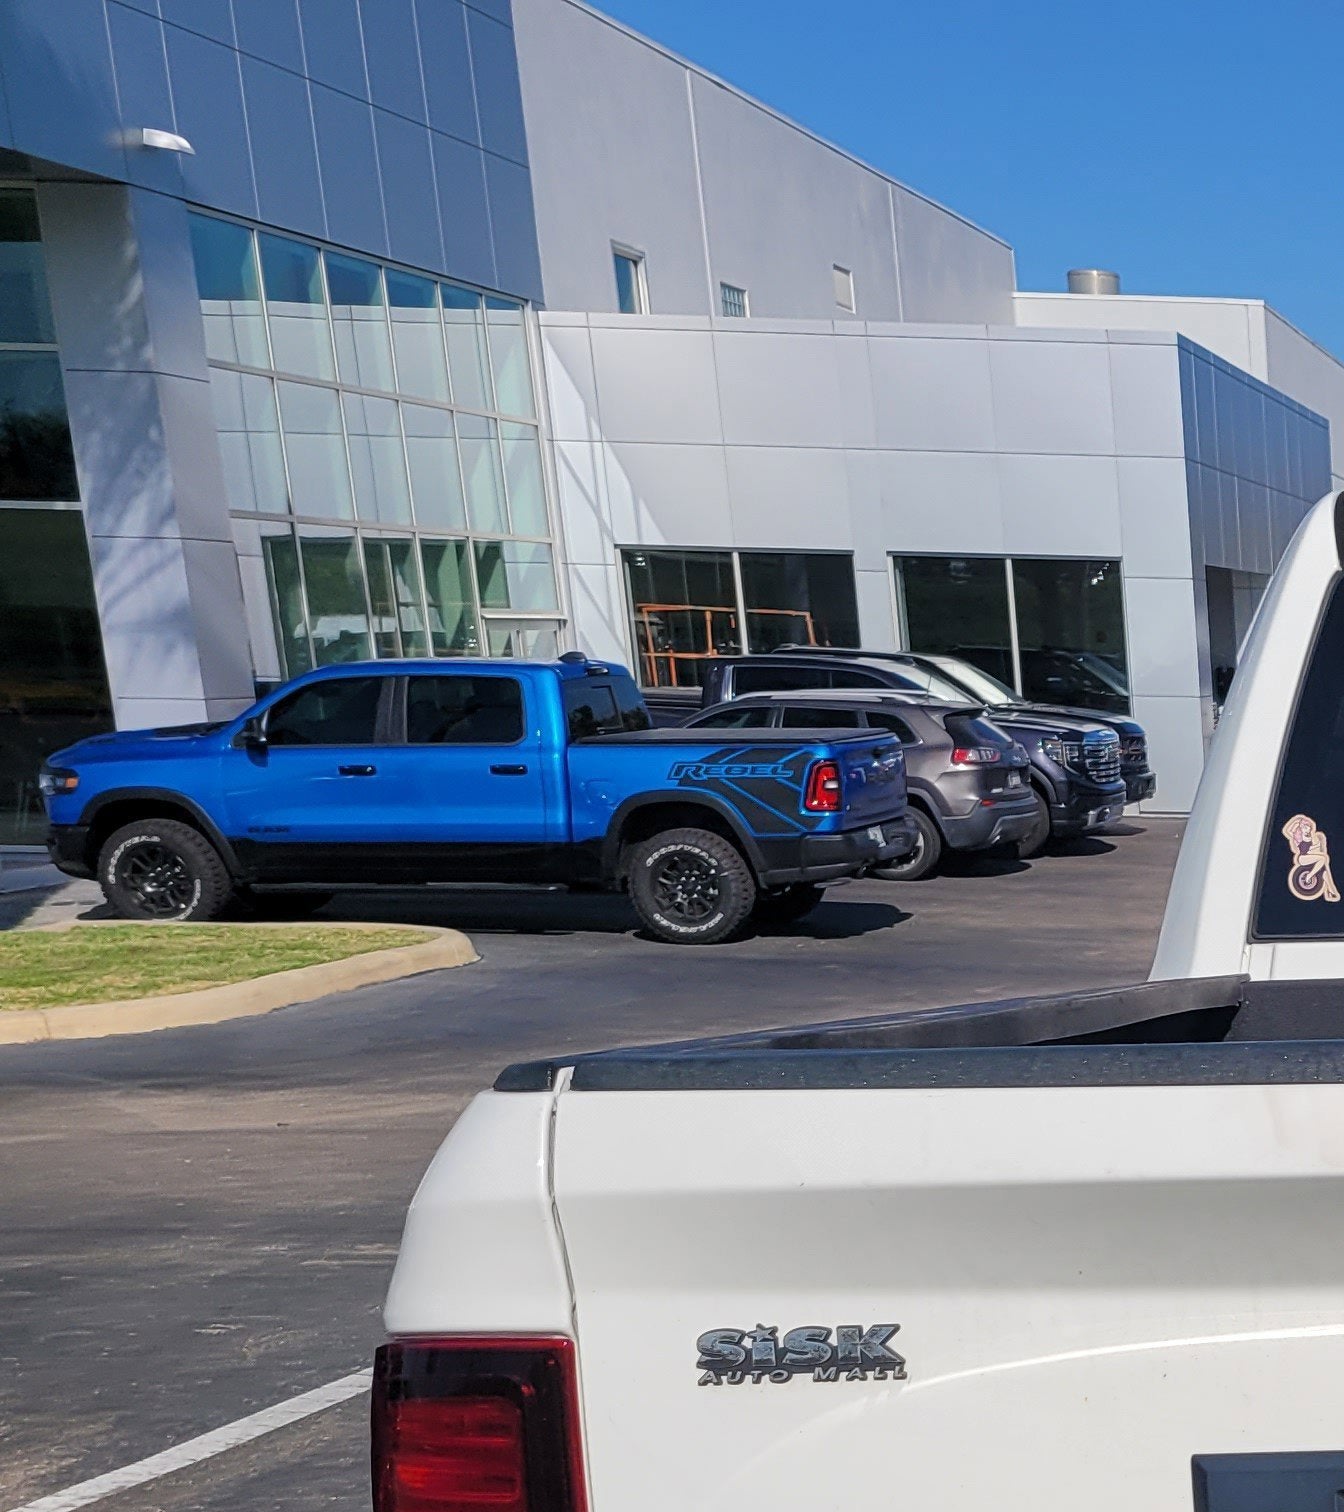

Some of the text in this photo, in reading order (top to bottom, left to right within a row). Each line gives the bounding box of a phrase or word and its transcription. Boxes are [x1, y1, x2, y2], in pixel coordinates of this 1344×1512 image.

[668, 762, 795, 780] REBEL
[698, 1365, 908, 1386] AUTO MALL
